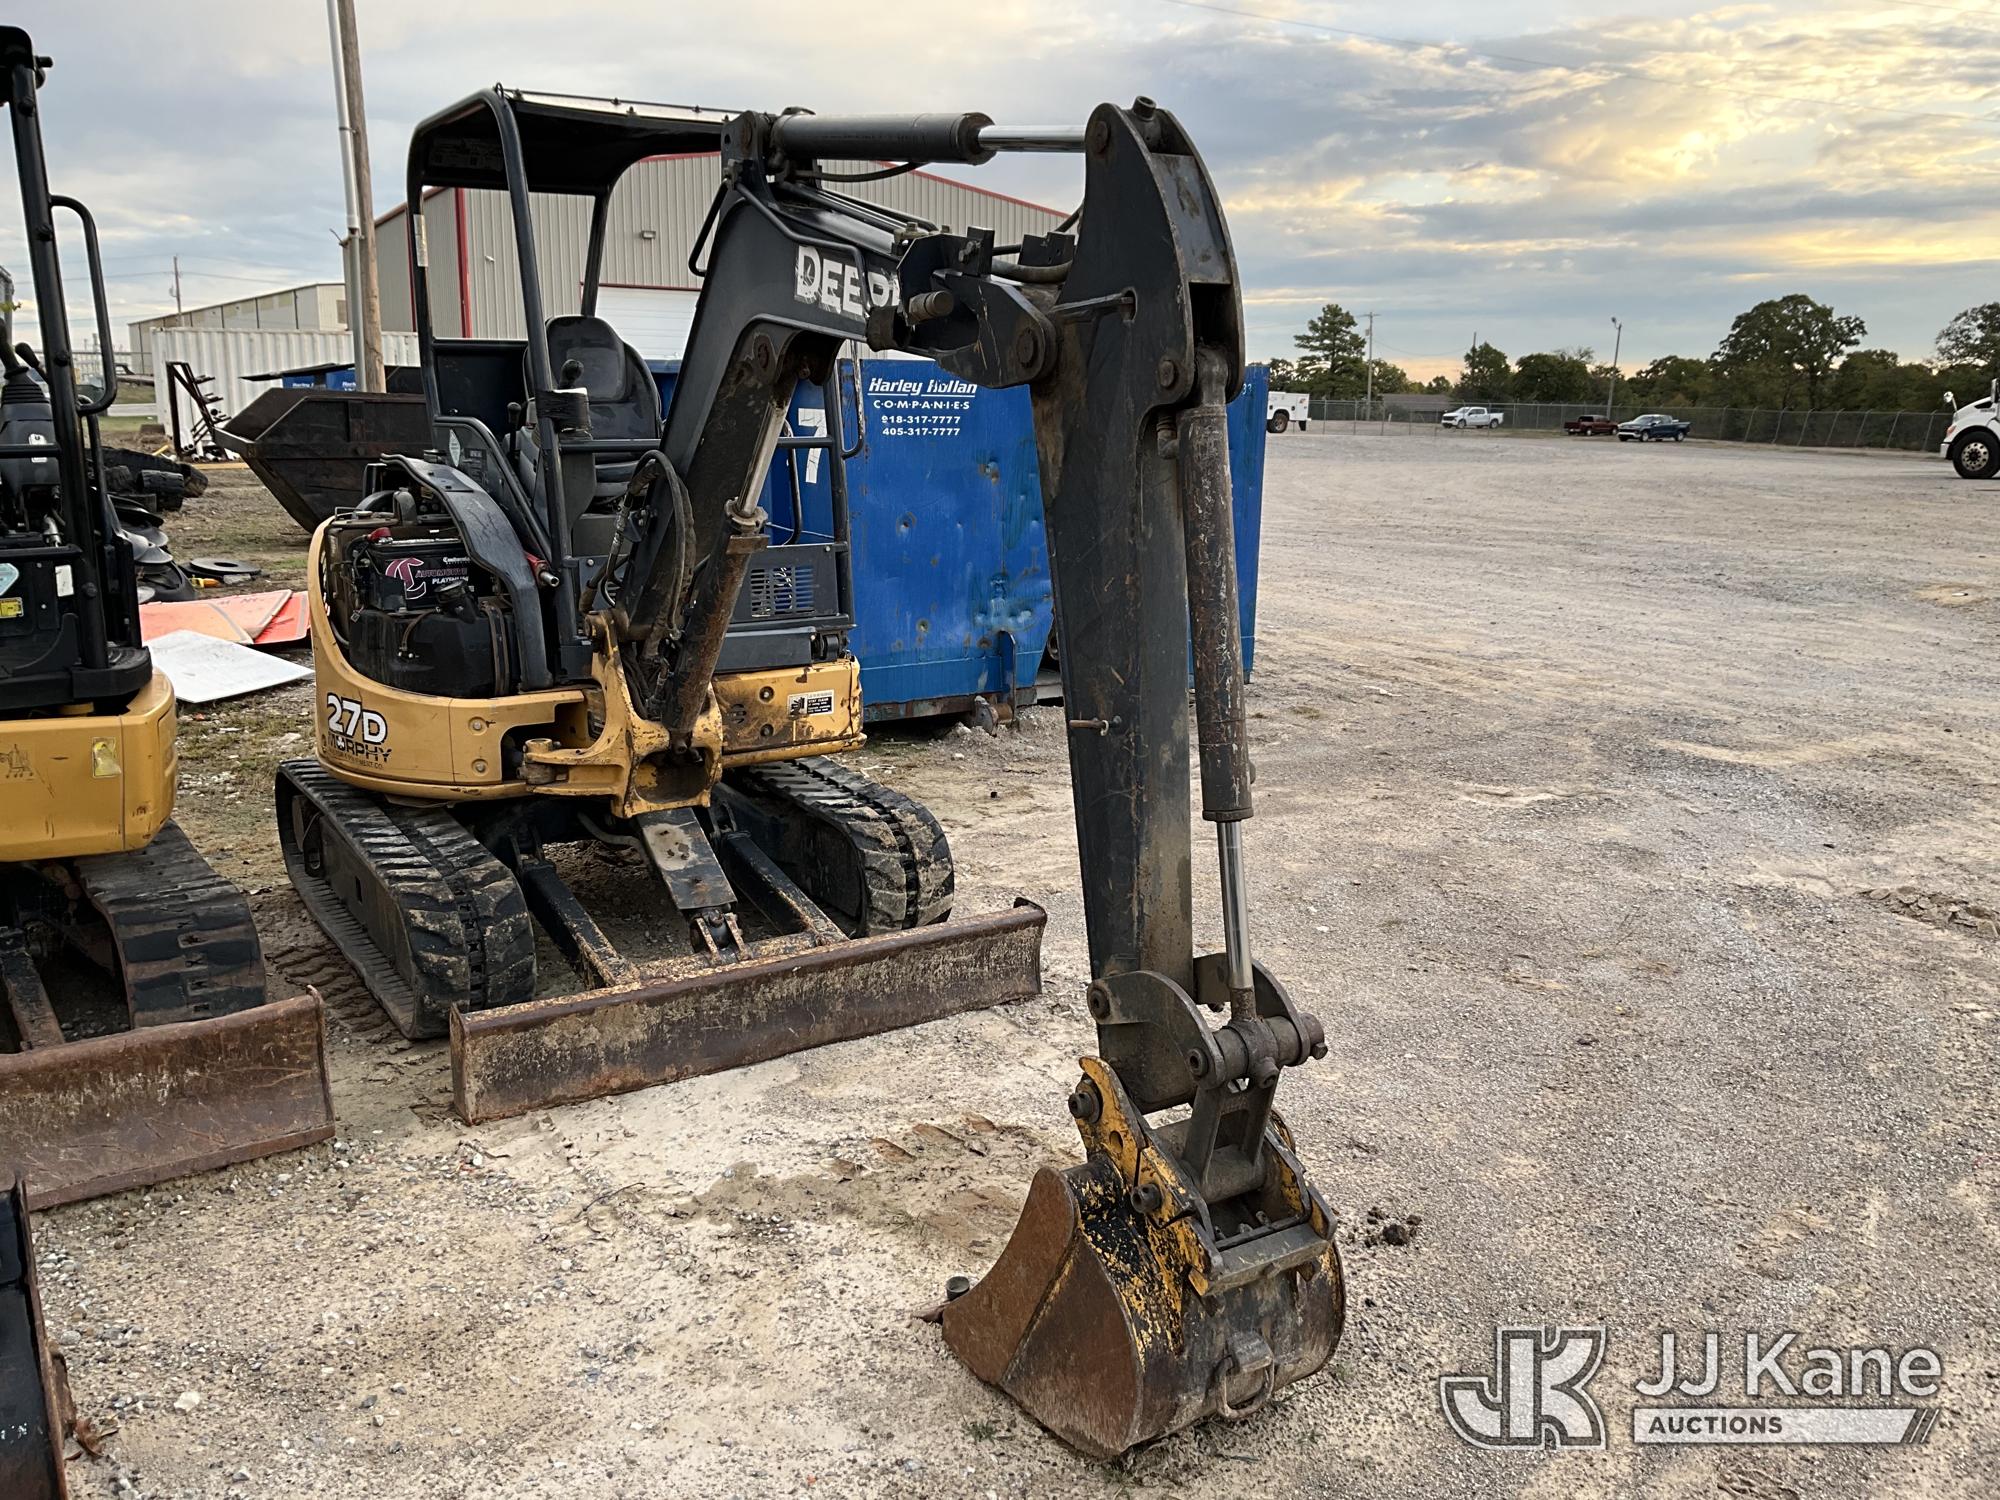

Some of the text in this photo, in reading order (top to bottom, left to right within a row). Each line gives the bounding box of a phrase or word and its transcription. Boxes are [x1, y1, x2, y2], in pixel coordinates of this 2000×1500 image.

[869, 377, 978, 396] Harley Hollan
[881, 415, 961, 424] 918-317-7777
[882, 427, 960, 436] 405-317-7777
[327, 692, 388, 745] 27D
